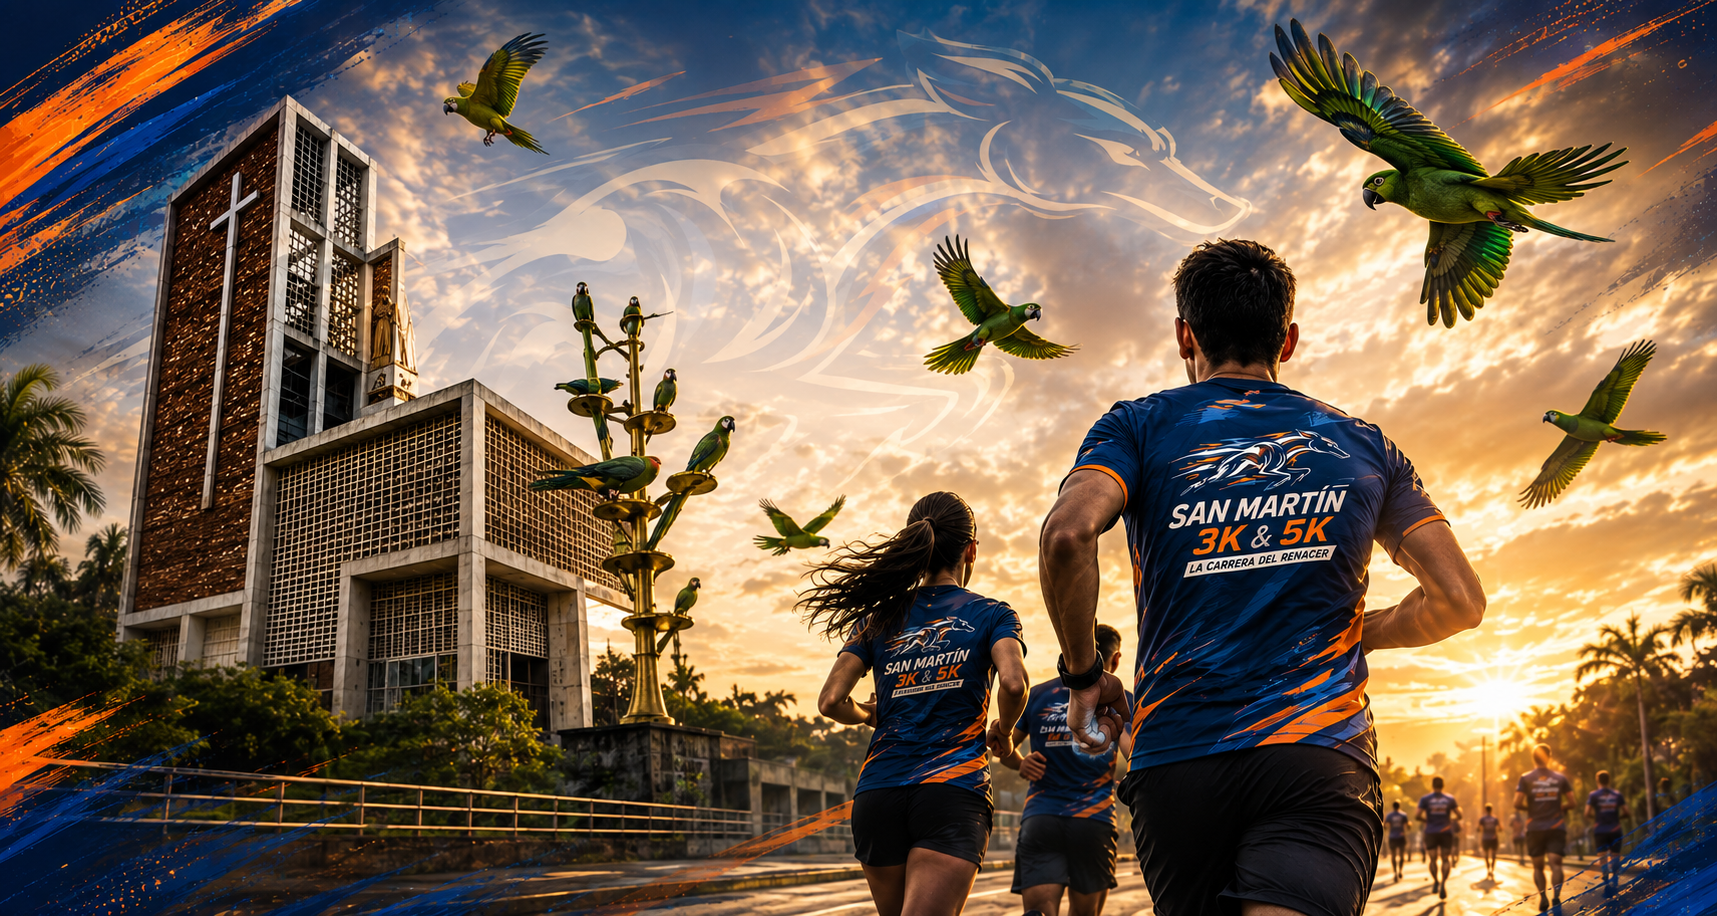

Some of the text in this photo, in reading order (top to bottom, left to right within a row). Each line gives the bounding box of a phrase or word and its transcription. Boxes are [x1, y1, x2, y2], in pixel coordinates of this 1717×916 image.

[1168, 485, 1347, 529] SAN MARTÍN
[1192, 516, 1334, 555] 3K & 5K
[1189, 549, 1329, 574] LA CARRERA DEL RENACER
[884, 647, 970, 675] SAN MARTÍN
[895, 663, 962, 687] 3K & 5K
